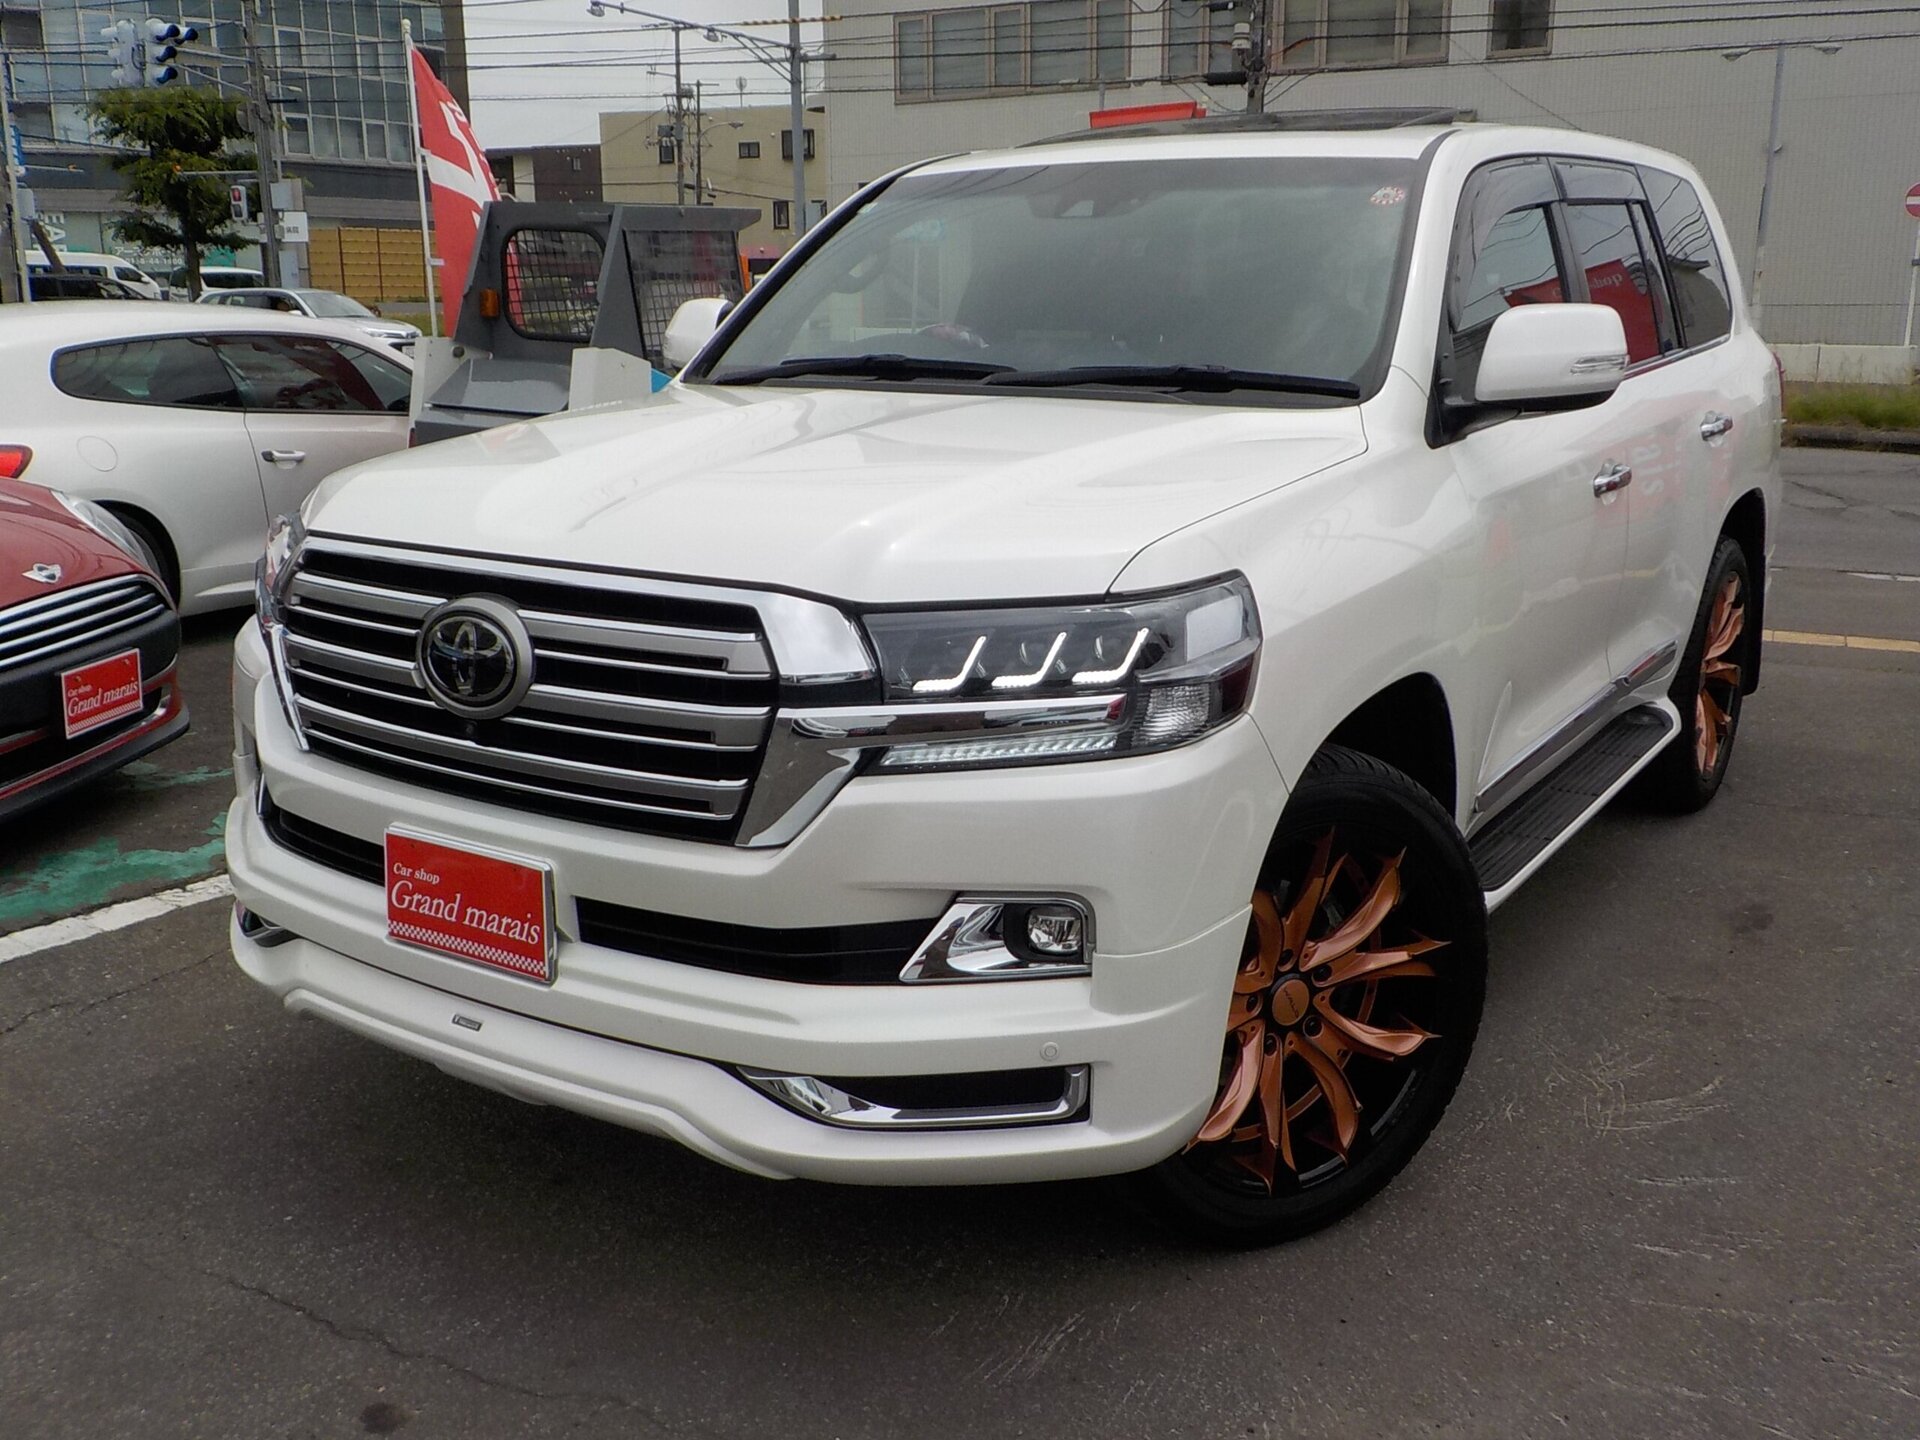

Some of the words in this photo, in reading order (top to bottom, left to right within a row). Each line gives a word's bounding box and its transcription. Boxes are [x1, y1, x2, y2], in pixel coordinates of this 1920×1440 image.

[68, 688, 102, 717] Grand
[103, 677, 138, 705] marais
[393, 862, 413, 877] Car
[414, 868, 440, 885] shop
[391, 880, 462, 922] Grand
[462, 912, 541, 945] marais
[1284, 986, 1300, 1019] WALD
